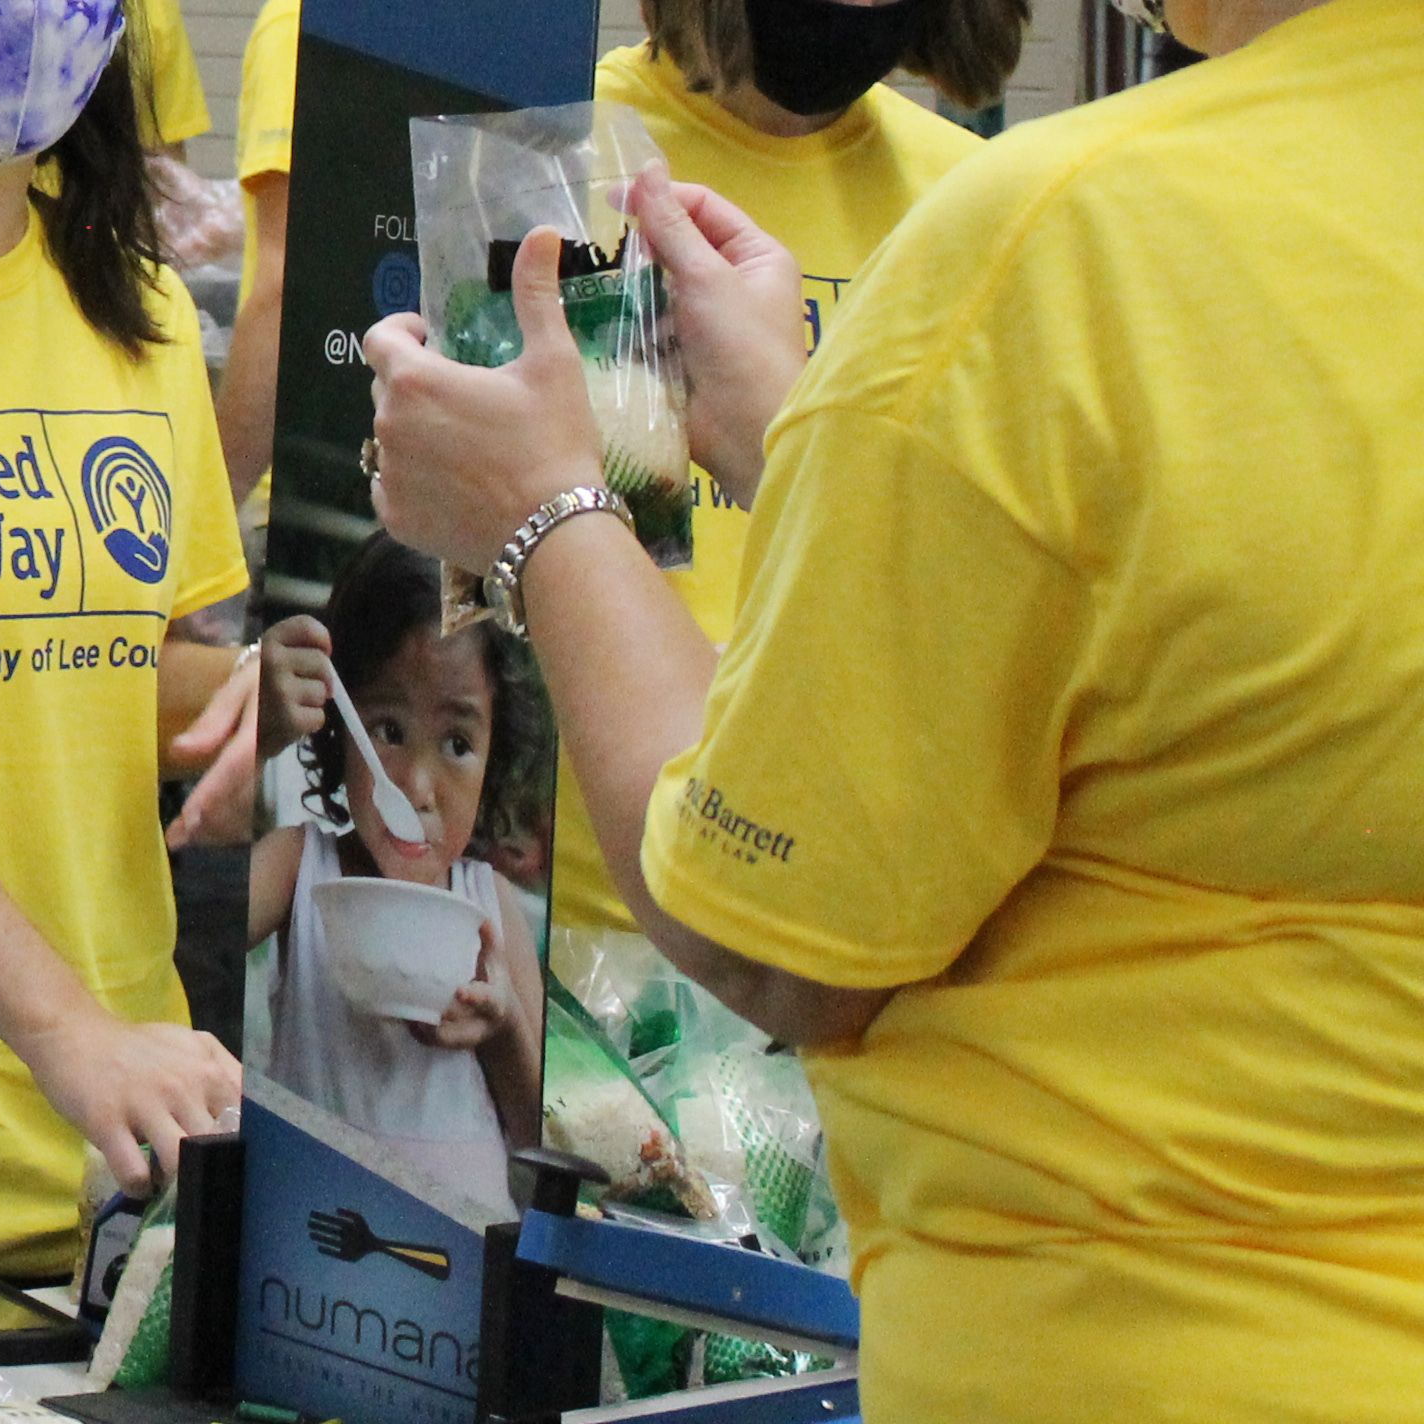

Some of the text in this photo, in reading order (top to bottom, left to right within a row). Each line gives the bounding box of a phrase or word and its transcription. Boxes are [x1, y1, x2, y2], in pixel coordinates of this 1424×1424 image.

[324, 328, 367, 366] @N
[31, 638, 54, 672] of
[59, 639, 99, 670] Lee
[109, 636, 158, 668] Co
[701, 787, 795, 862] Barrett
